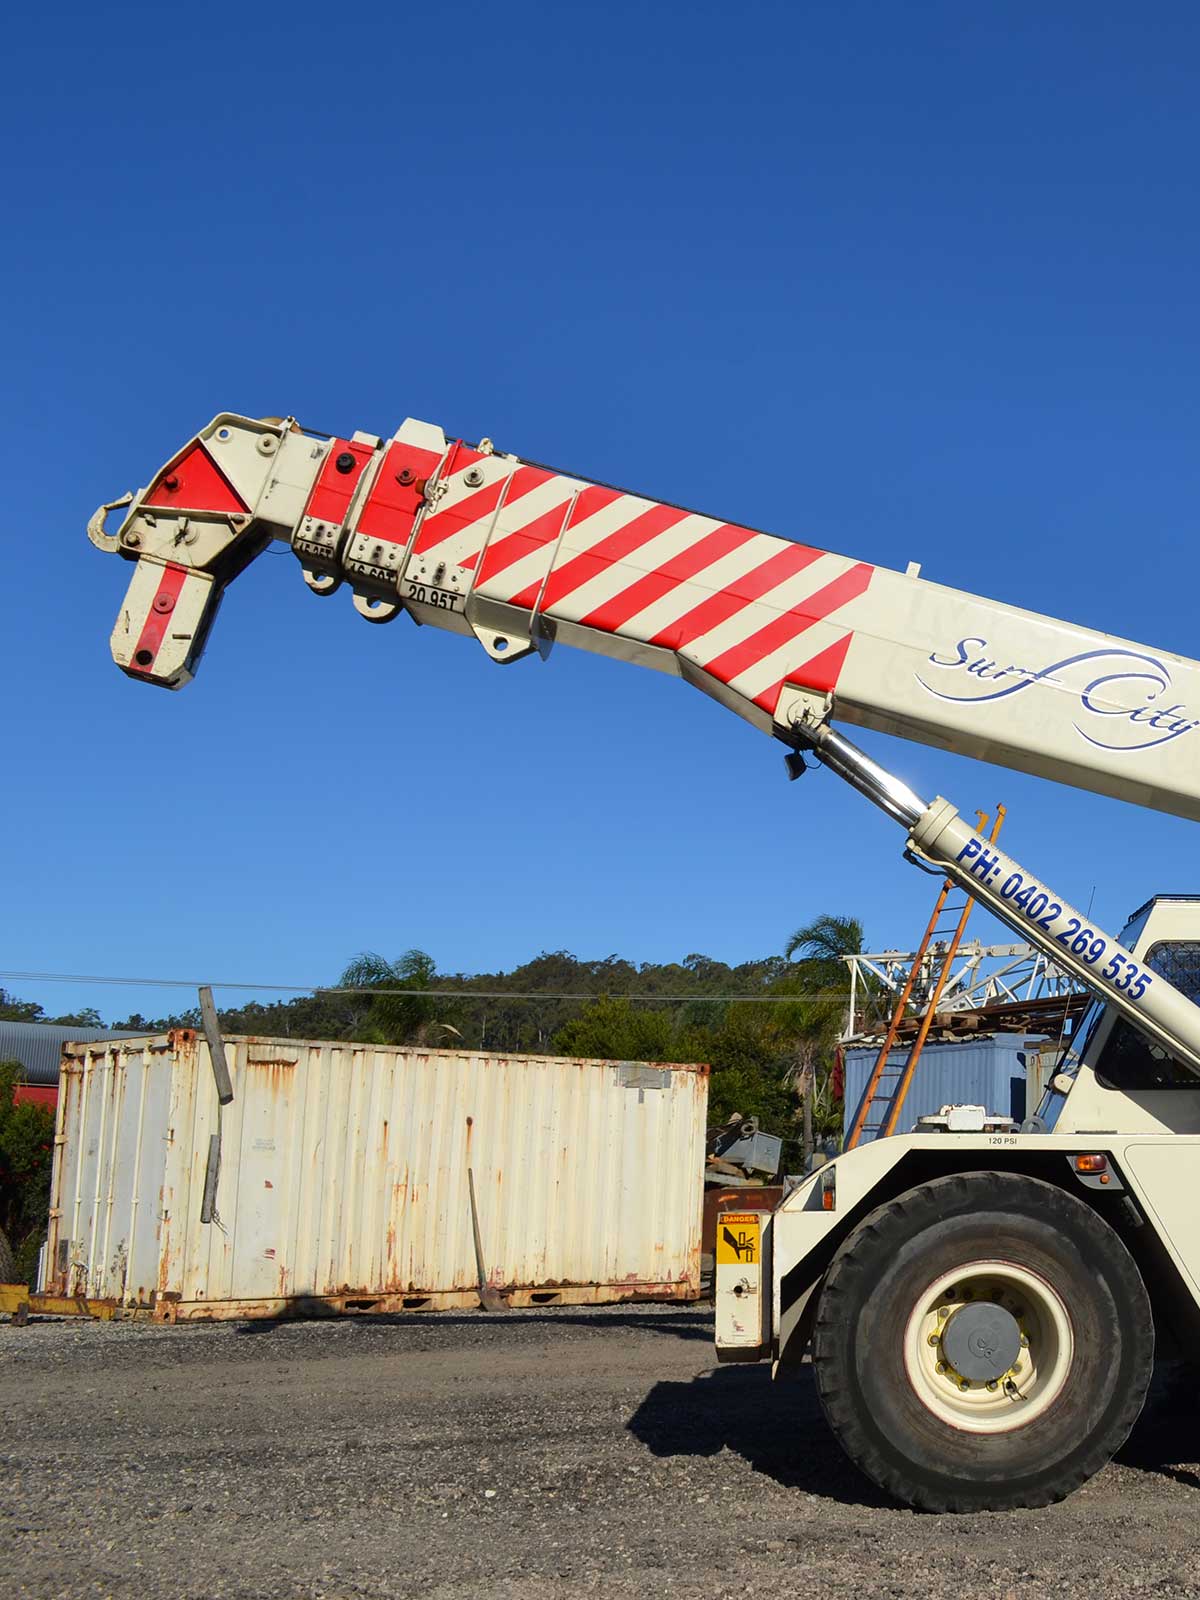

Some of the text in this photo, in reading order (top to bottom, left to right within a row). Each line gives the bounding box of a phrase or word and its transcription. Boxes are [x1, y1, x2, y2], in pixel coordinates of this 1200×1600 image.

[351, 563, 397, 583] 1660T
[409, 584, 458, 611] 20.95T
[1072, 673, 1200, 750] City
[955, 838, 1153, 1001] PH: 0402 269 535
[989, 1137, 1017, 1145] 120 PSI
[723, 1215, 756, 1223] DANGER
